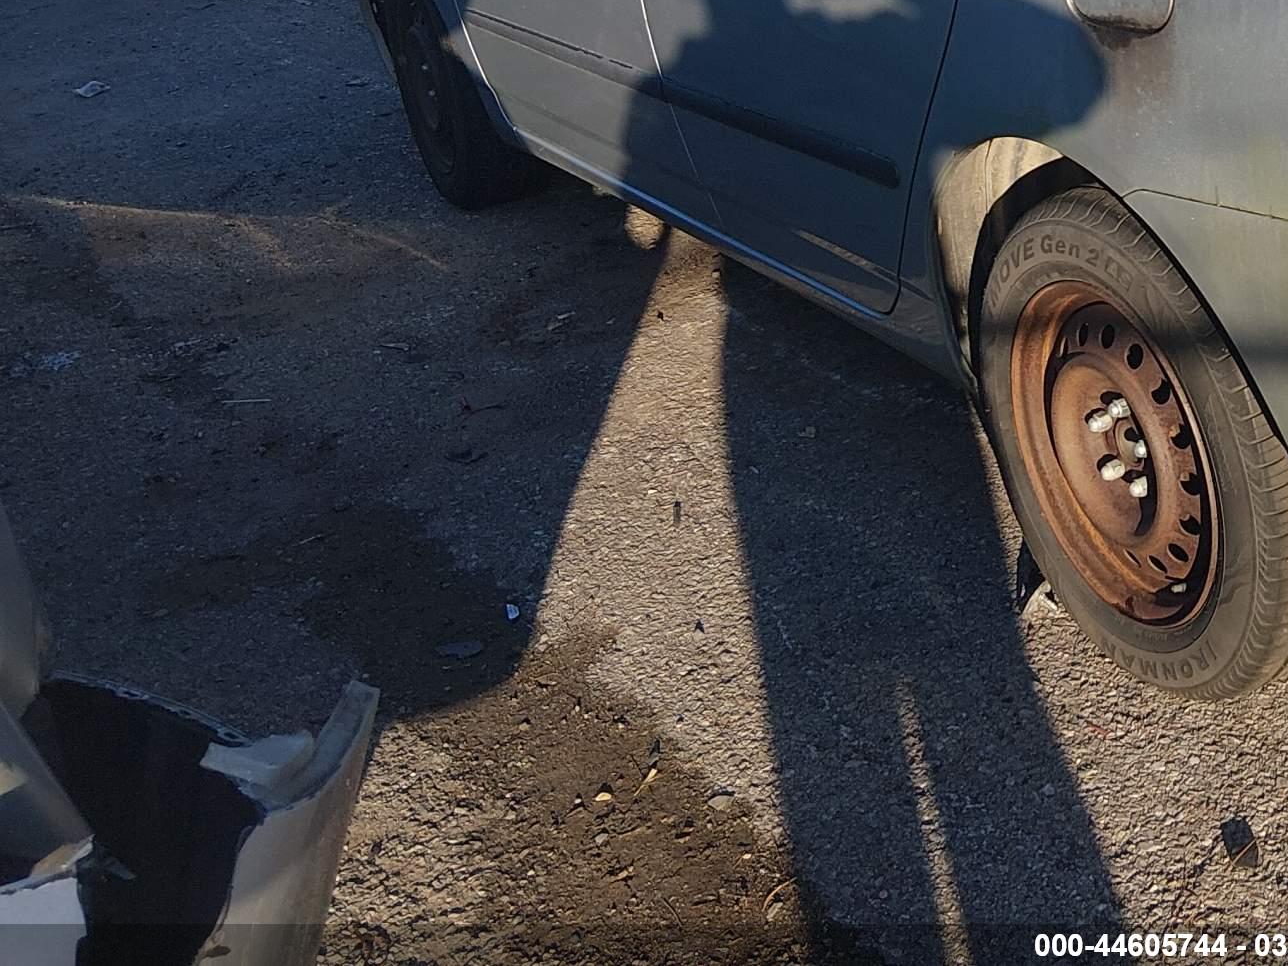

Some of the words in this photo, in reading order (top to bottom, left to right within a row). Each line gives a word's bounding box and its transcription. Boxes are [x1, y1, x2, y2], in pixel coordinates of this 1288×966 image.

[1040, 234, 1081, 259] Gen
[1085, 247, 1101, 268] 2
[1100, 638, 1218, 681] IRONMAN
